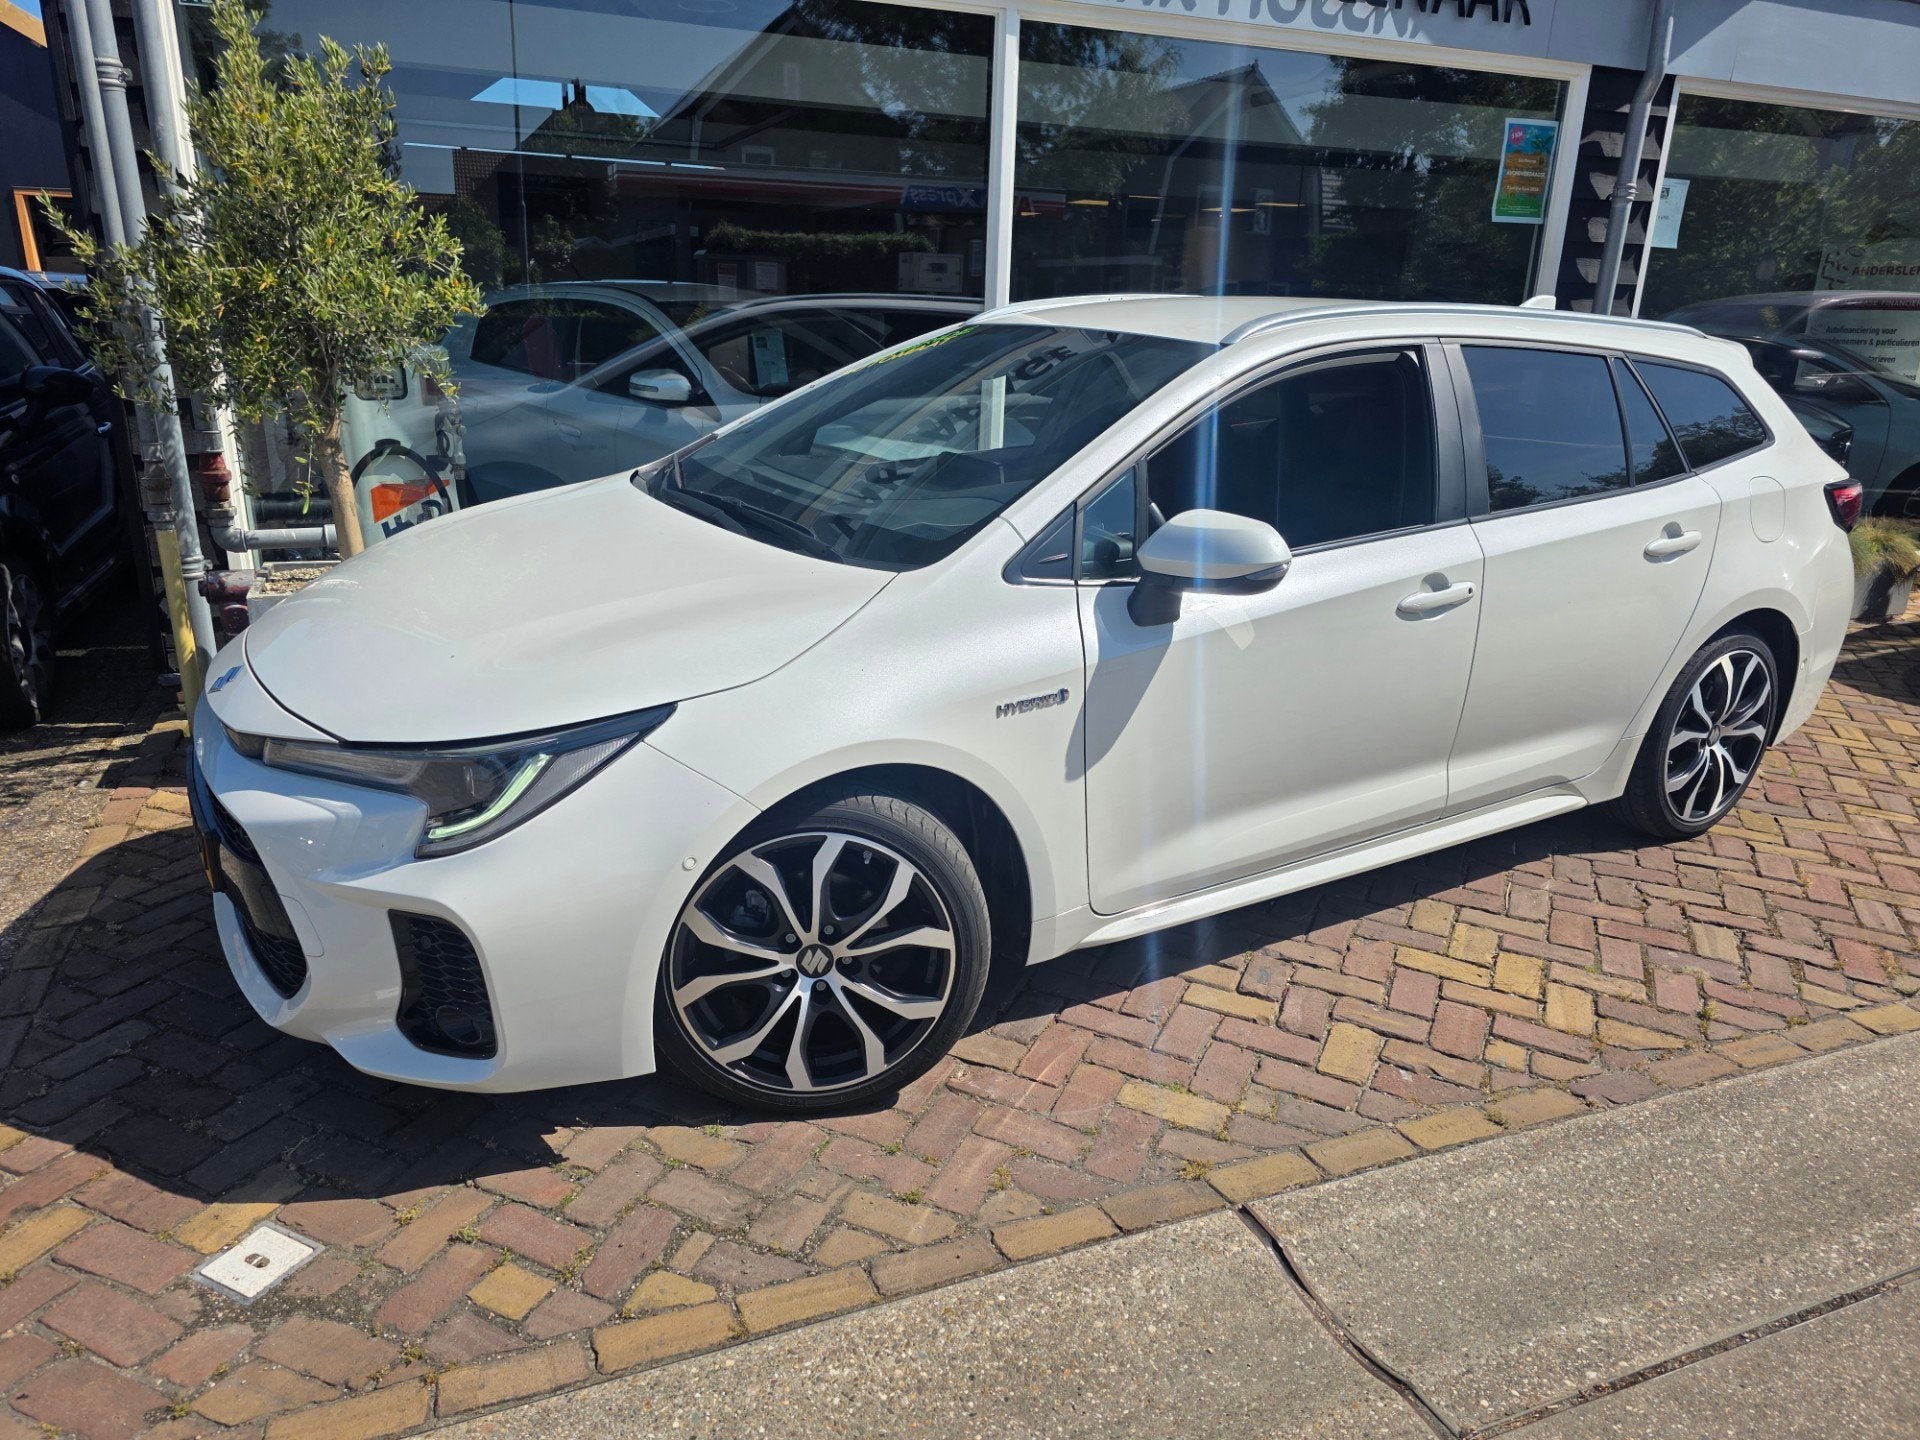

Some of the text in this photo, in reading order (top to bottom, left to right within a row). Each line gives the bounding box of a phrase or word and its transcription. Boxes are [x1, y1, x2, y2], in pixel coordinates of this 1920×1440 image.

[1825, 326, 1880, 336] Autofinanciering
[1875, 339, 1920, 347] particulieren
[996, 693, 1058, 718] HYBRID
